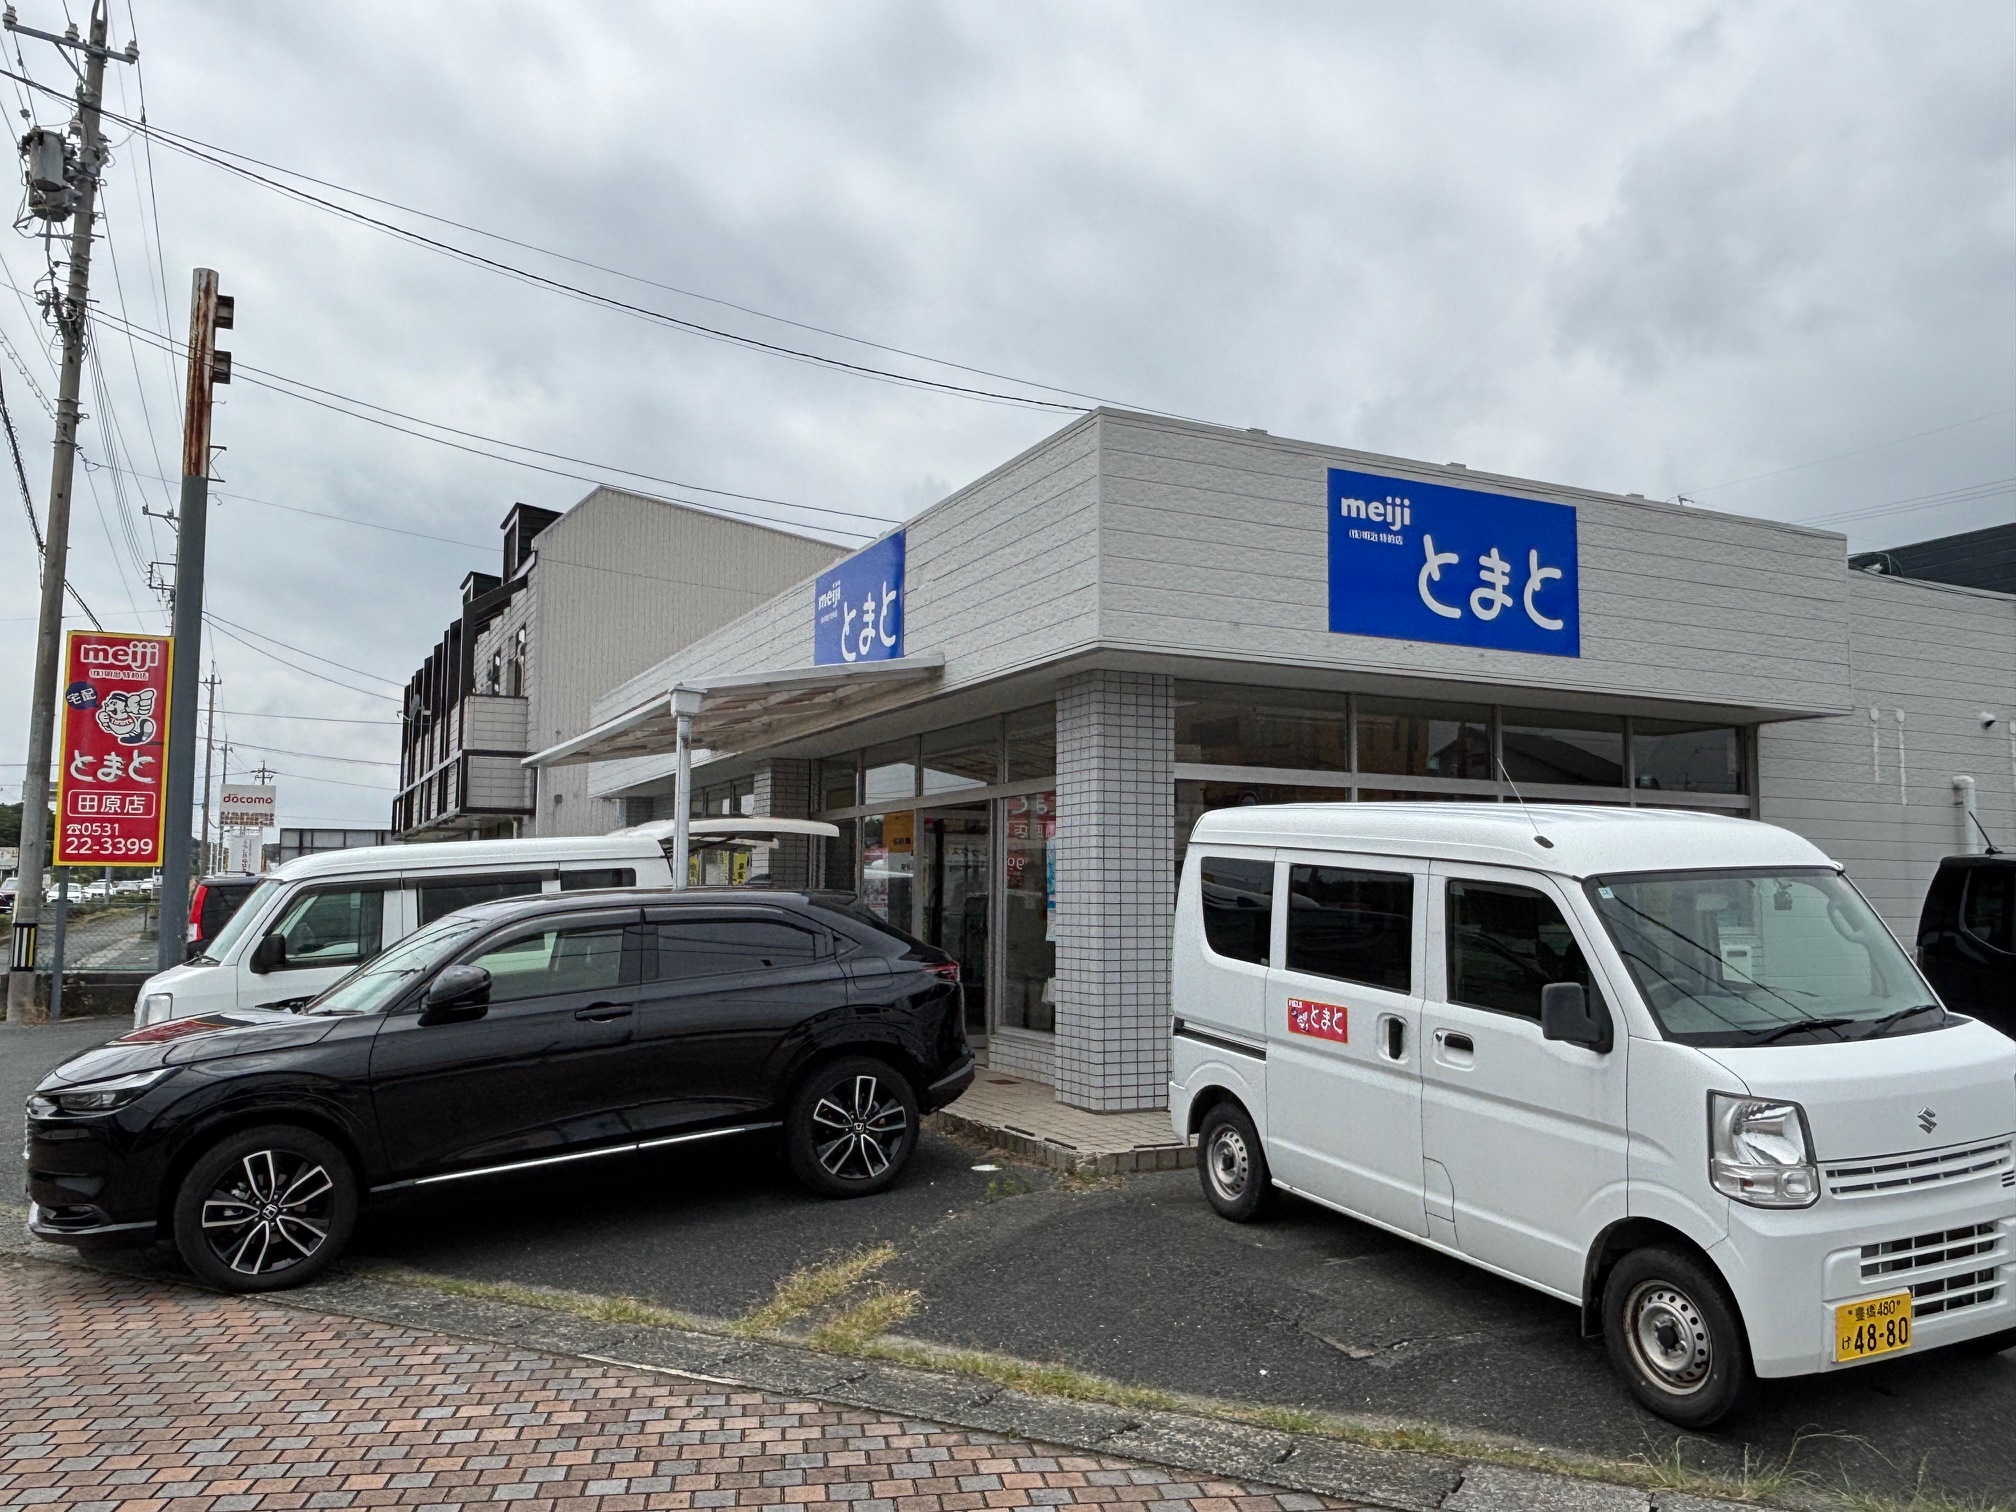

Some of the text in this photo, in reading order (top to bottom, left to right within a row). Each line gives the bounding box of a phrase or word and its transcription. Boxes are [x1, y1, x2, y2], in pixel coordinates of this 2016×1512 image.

[1341, 496, 1411, 531] meiji
[818, 580, 841, 610] meiji
[1418, 534, 1564, 631] とまと
[841, 581, 897, 662] とまと
[81, 641, 159, 670] meiji
[67, 687, 97, 705] 宅配
[70, 749, 155, 784] とまと
[78, 795, 145, 814] 田原店
[223, 793, 274, 804] docomo
[81, 823, 119, 836] 0531
[65, 838, 153, 854] 22-3399
[1310, 1004, 1343, 1035] とまと
[1855, 1316, 1908, 1354] 48-80
